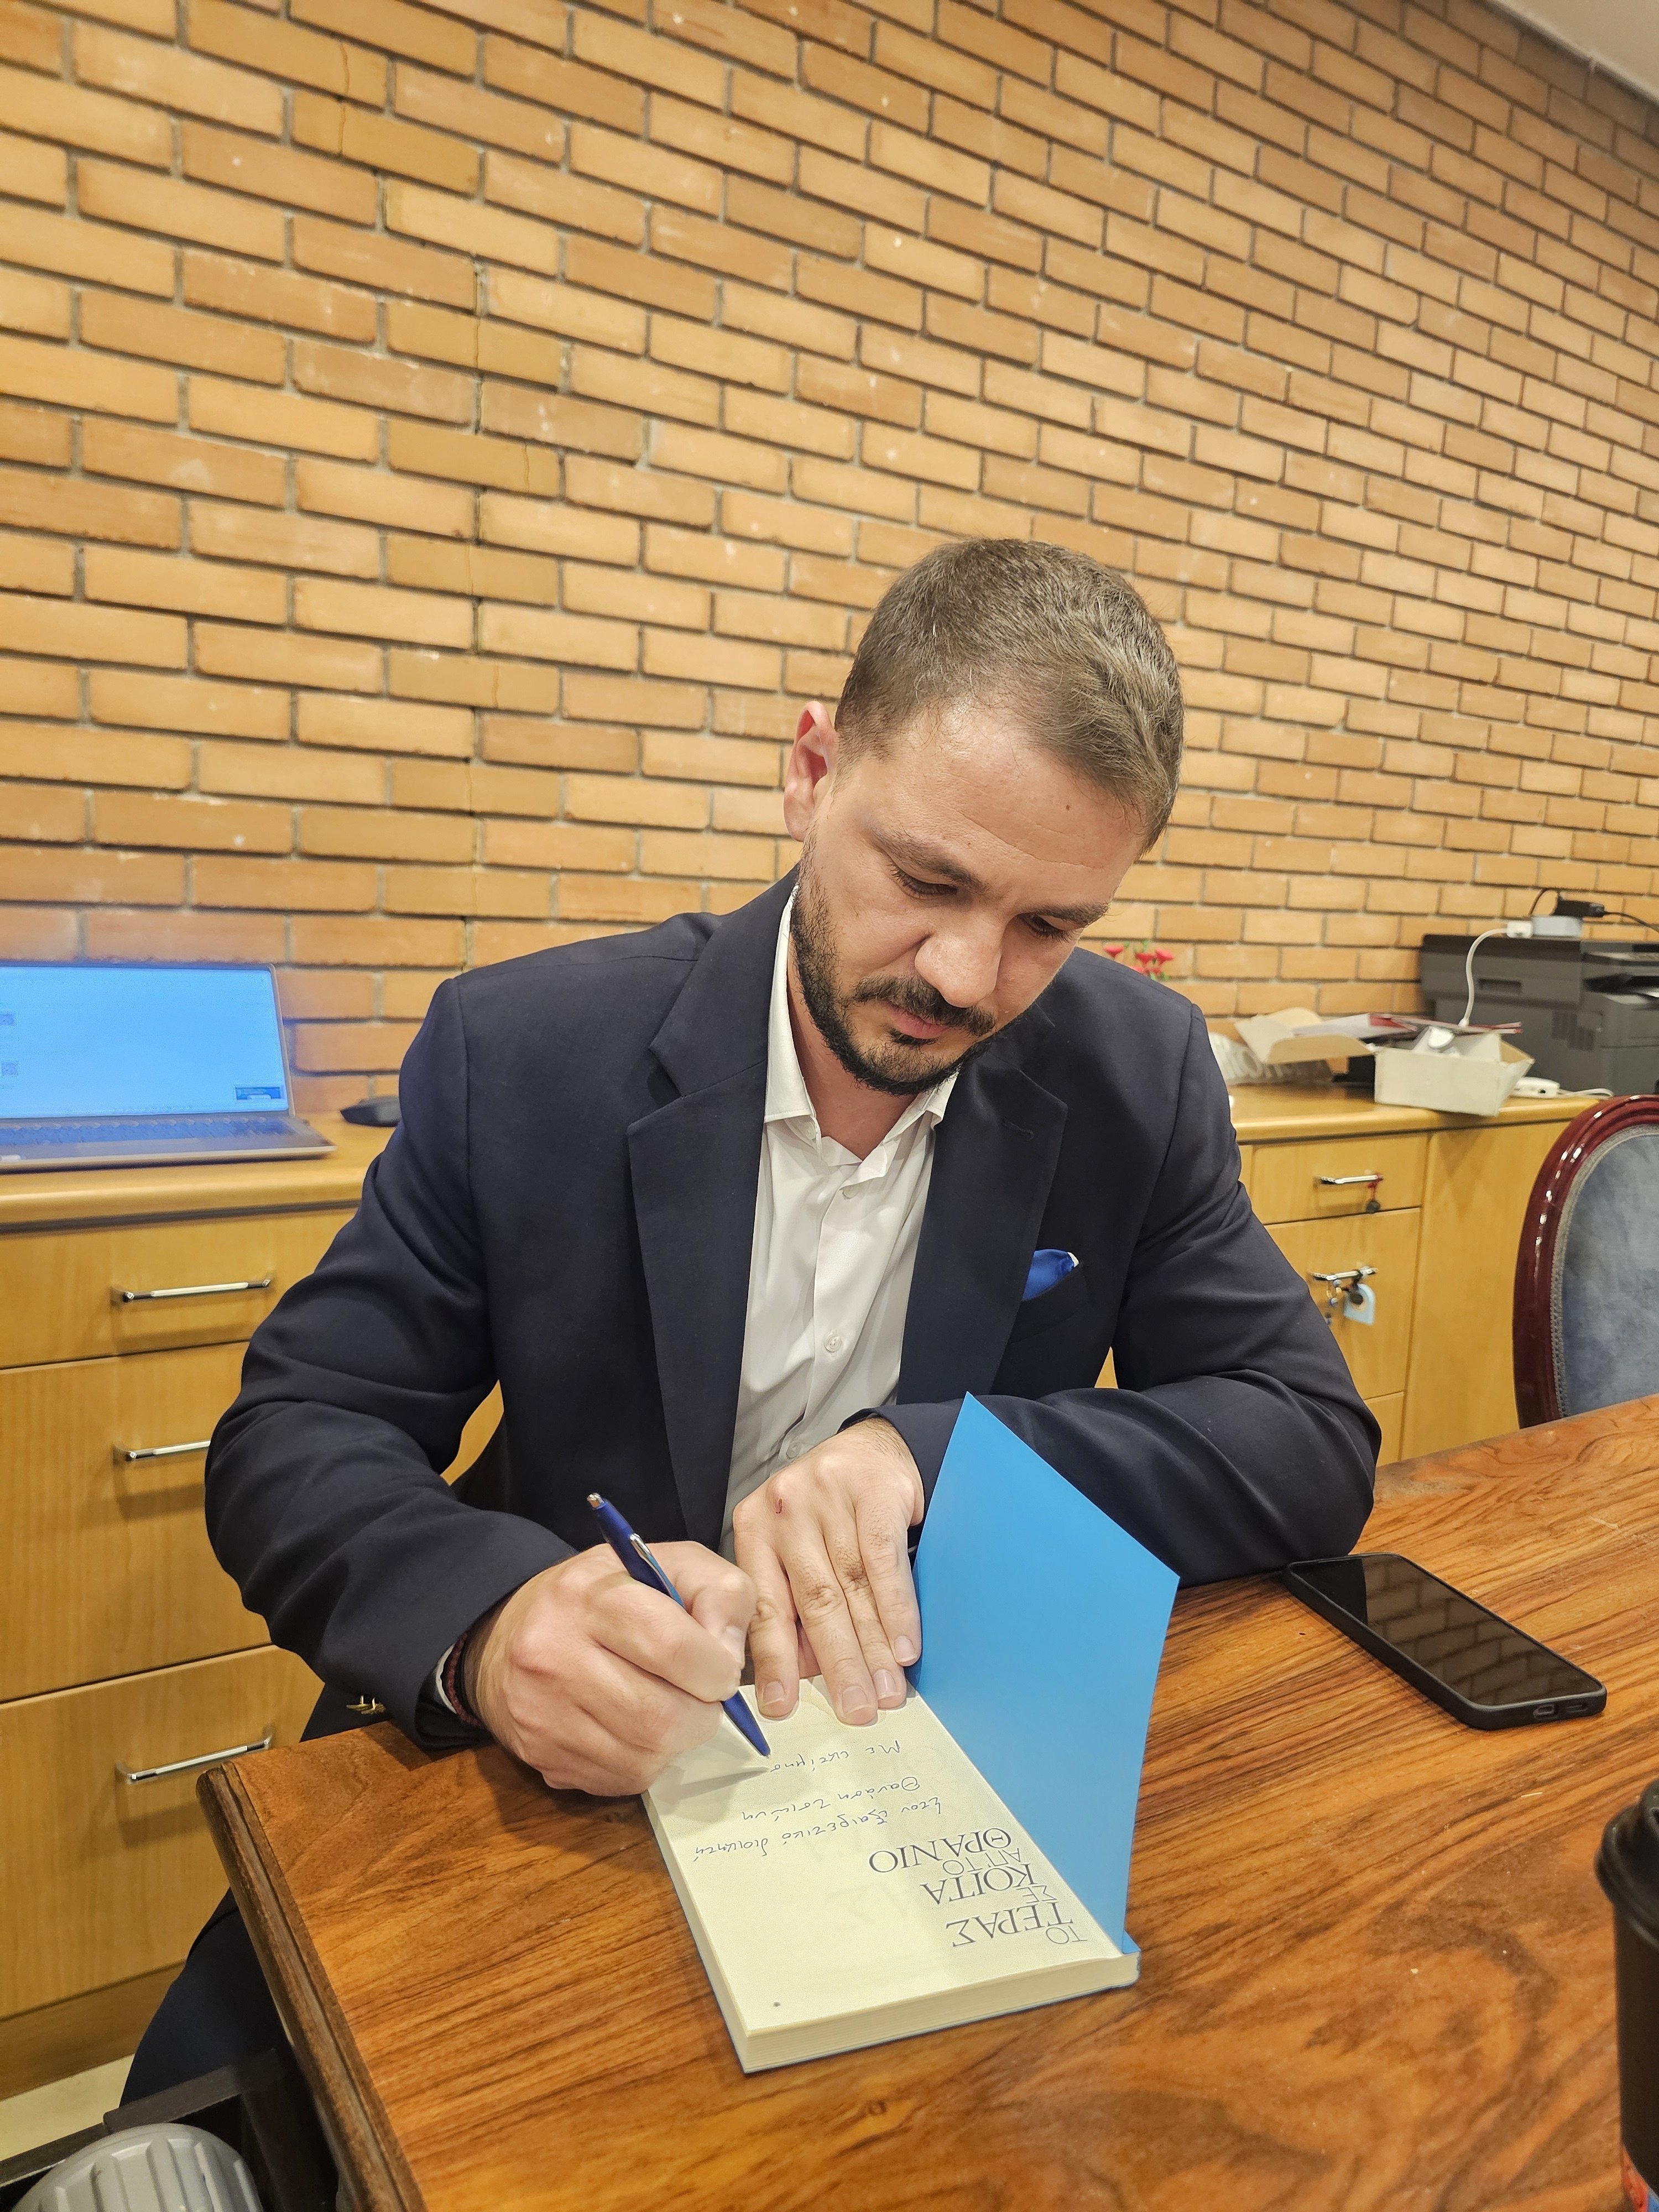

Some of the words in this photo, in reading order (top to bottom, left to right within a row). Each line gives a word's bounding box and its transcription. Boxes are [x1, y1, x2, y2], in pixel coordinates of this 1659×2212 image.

[868, 1828, 1011, 1873] ΘΡΑΝΙΟ
[942, 1857, 983, 1875] ΤΟ
[919, 1863, 1037, 1905] ΚΟΙΤΑ
[1016, 1885, 1057, 1903] ΣΕ
[945, 1902, 1073, 1947] ΤΕΡΑΣ
